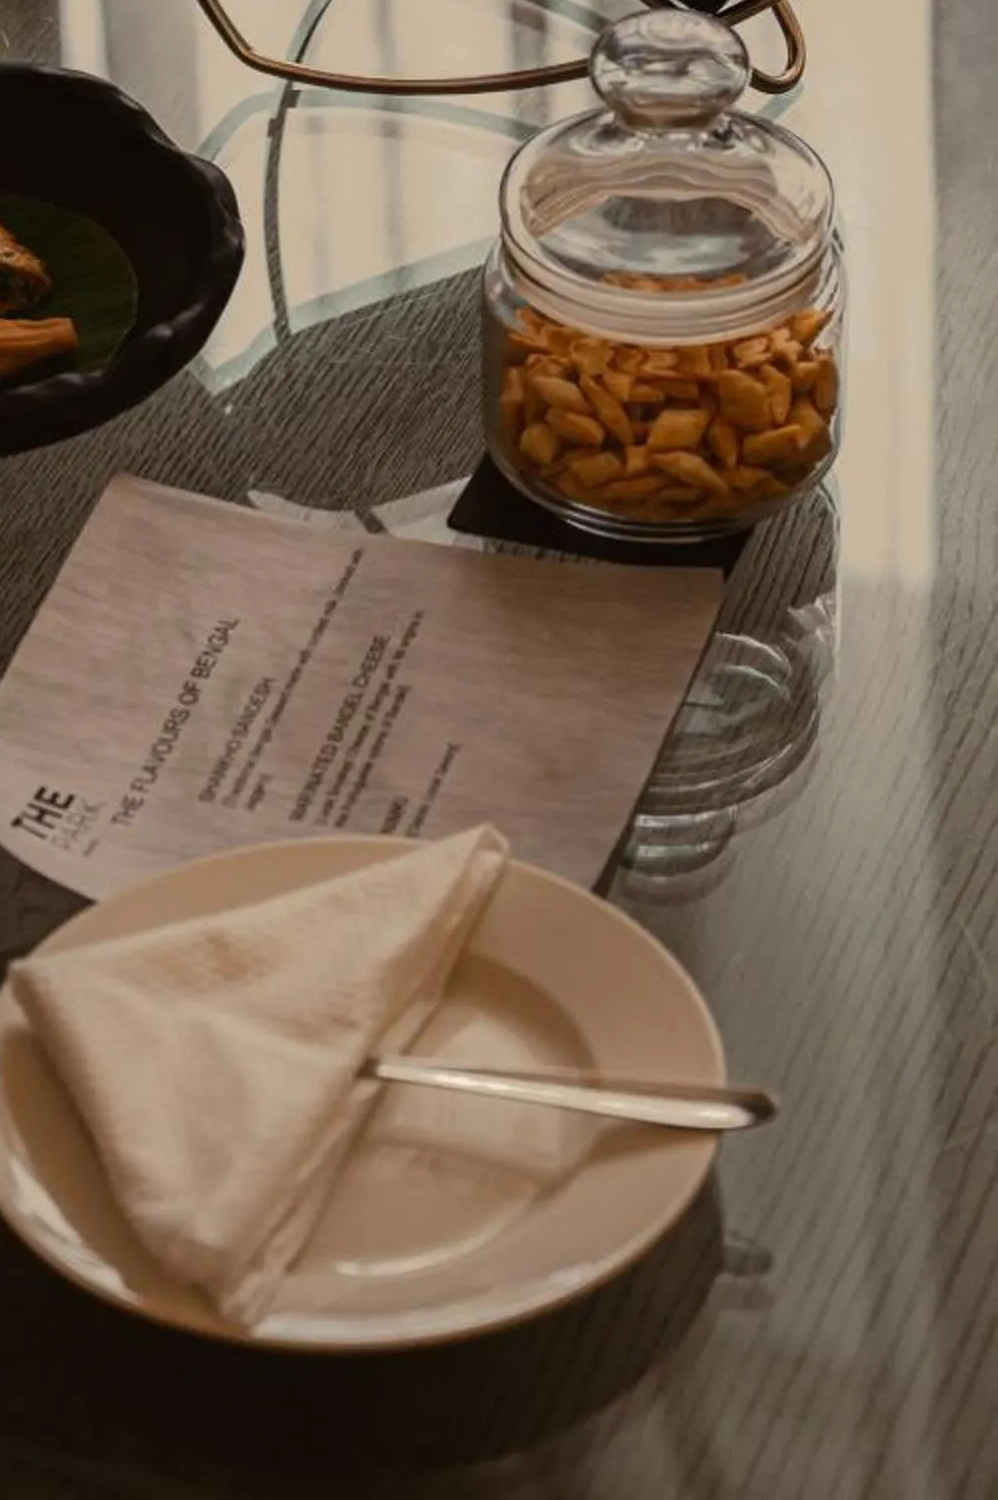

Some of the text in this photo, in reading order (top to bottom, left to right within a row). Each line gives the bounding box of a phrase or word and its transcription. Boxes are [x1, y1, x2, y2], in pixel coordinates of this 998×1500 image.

[109, 617, 241, 826] THE FLAVOURS OF BENGAL
[11, 786, 76, 840] THE
